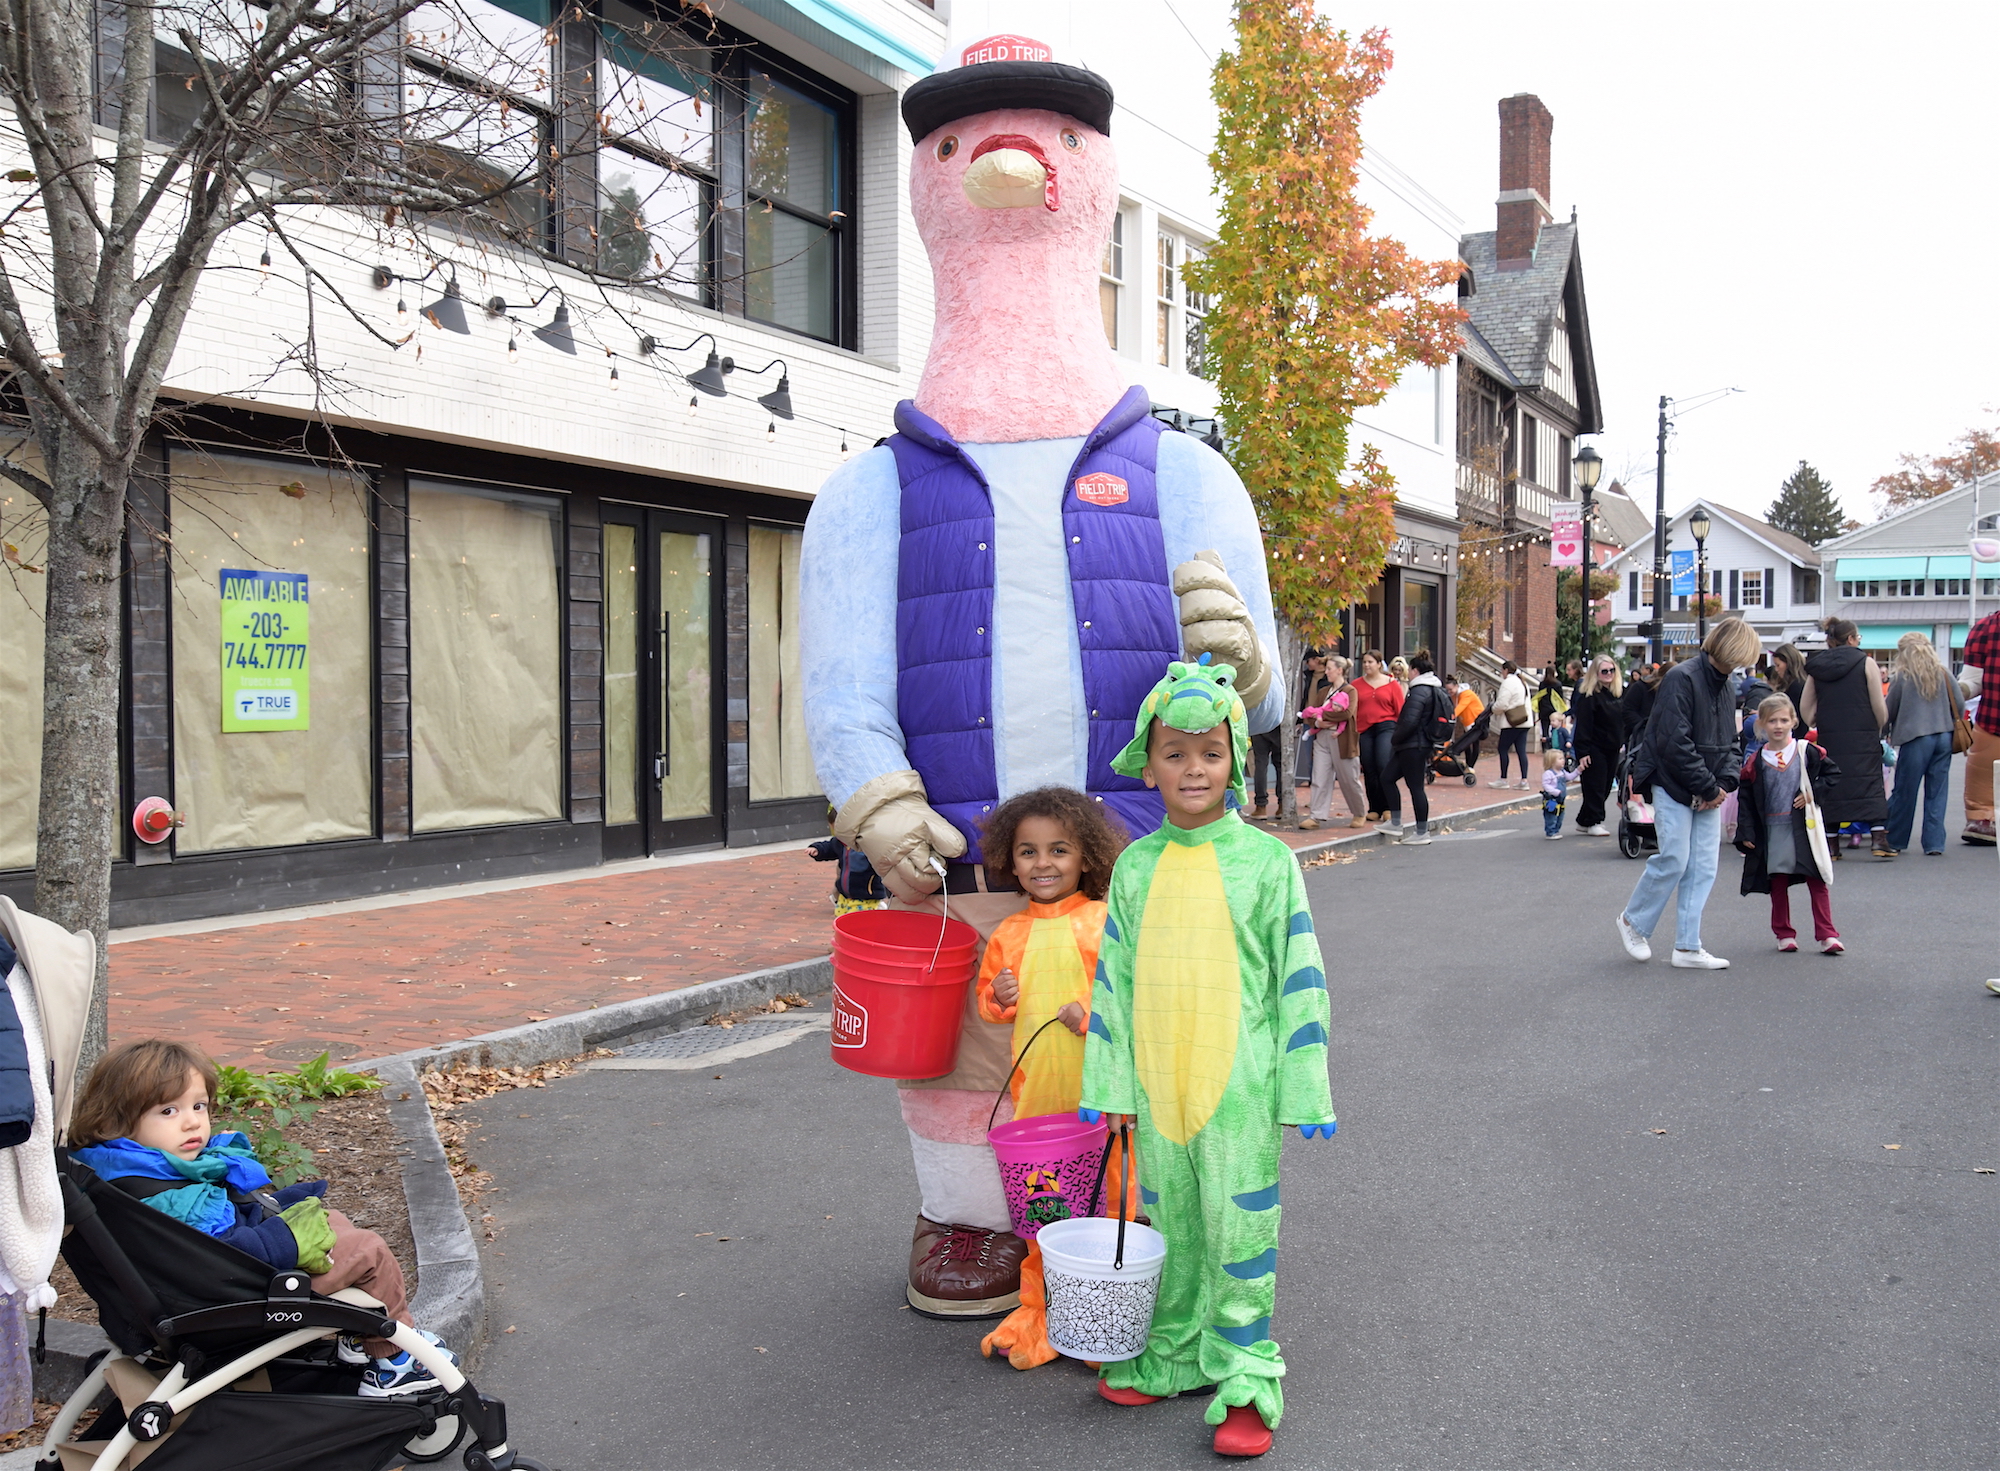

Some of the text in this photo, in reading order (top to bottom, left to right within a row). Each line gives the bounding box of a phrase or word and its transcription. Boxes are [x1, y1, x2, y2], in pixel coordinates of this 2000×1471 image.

[966, 45, 1048, 65] FIELD TRIP
[1079, 483, 1126, 496] FIELD TRIP
[222, 577, 307, 604] AVAILABLE
[243, 612, 289, 639] -203-
[224, 642, 307, 669] 744.7777
[240, 676, 292, 687] truecre.com
[257, 696, 291, 708] TRUE
[266, 1311, 303, 1322] YOYO
